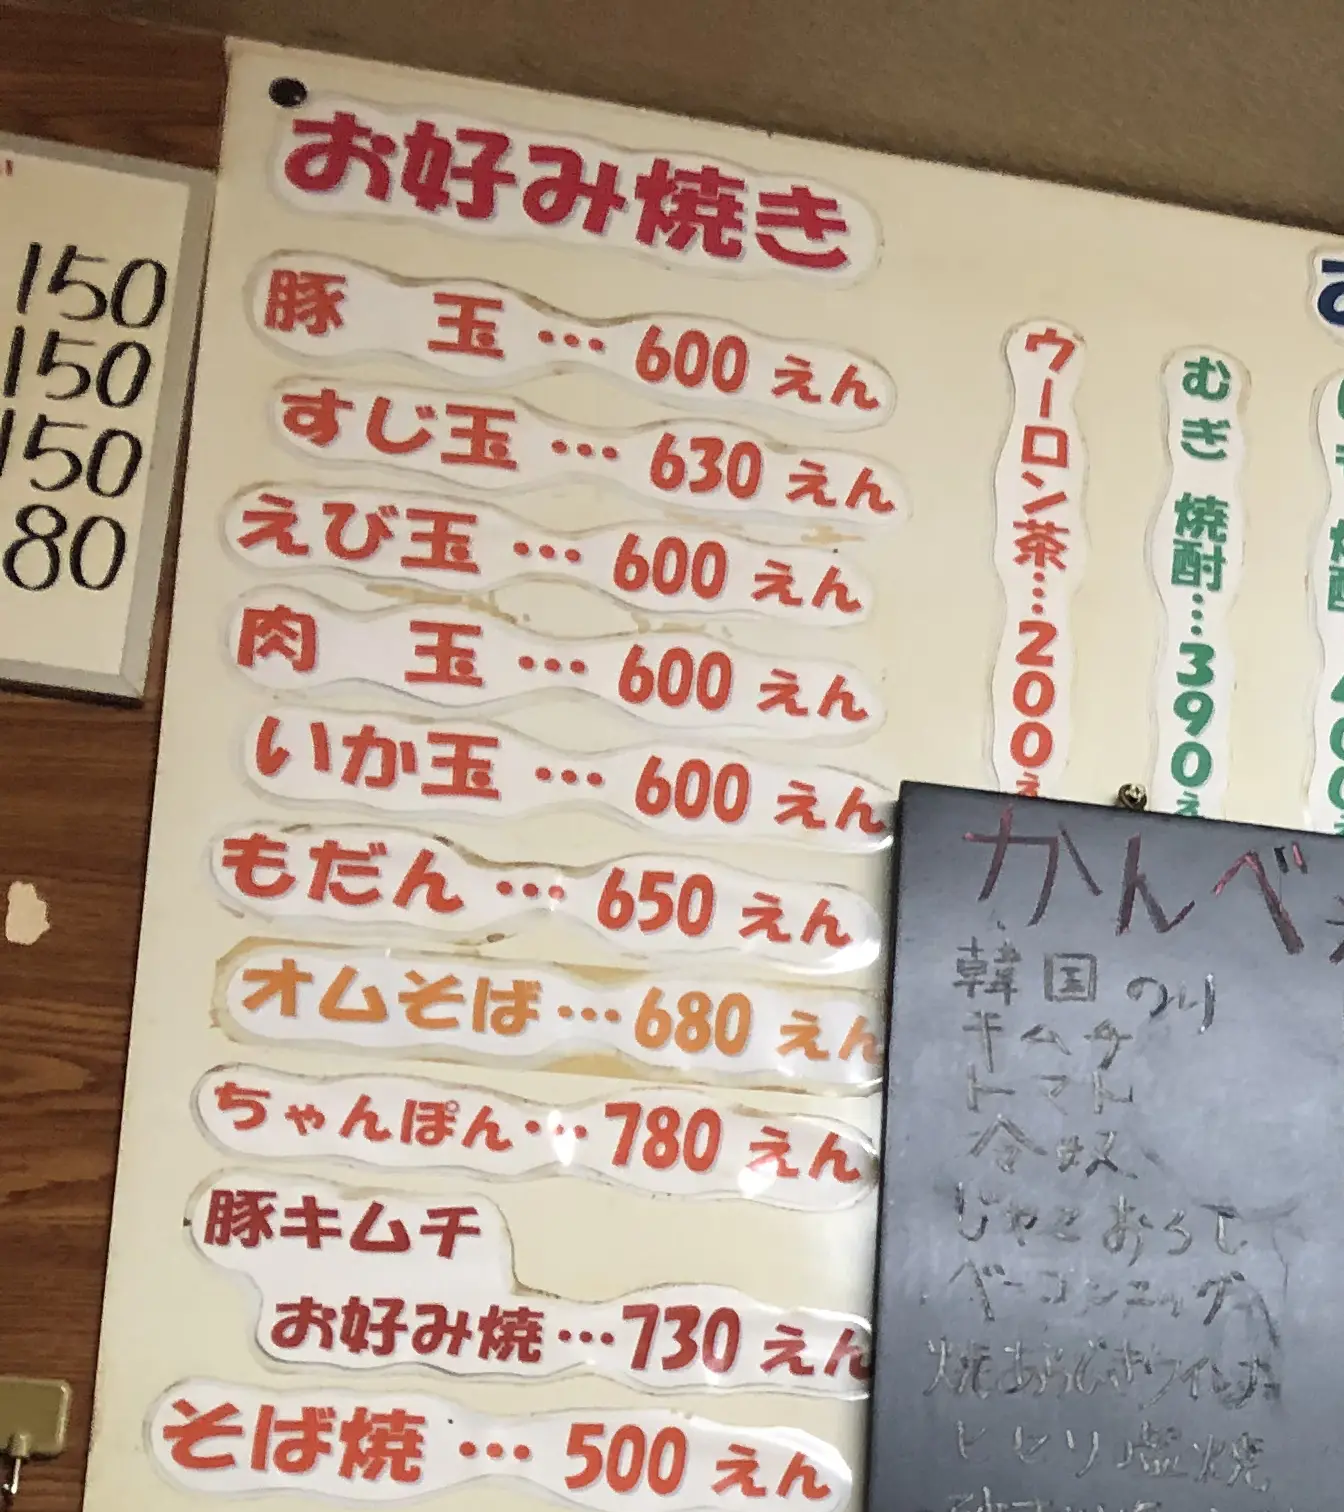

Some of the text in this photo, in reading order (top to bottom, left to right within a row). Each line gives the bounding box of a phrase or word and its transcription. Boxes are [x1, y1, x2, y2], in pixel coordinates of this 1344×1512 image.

[284, 111, 849, 268] お好み焼き
[17, 241, 168, 328] 150
[3, 325, 152, 409] 150
[0, 408, 143, 499] 150
[2, 503, 127, 591] 80
[965, 1061, 1135, 1115] トマト
[204, 1189, 481, 1260] 豚キムチ
